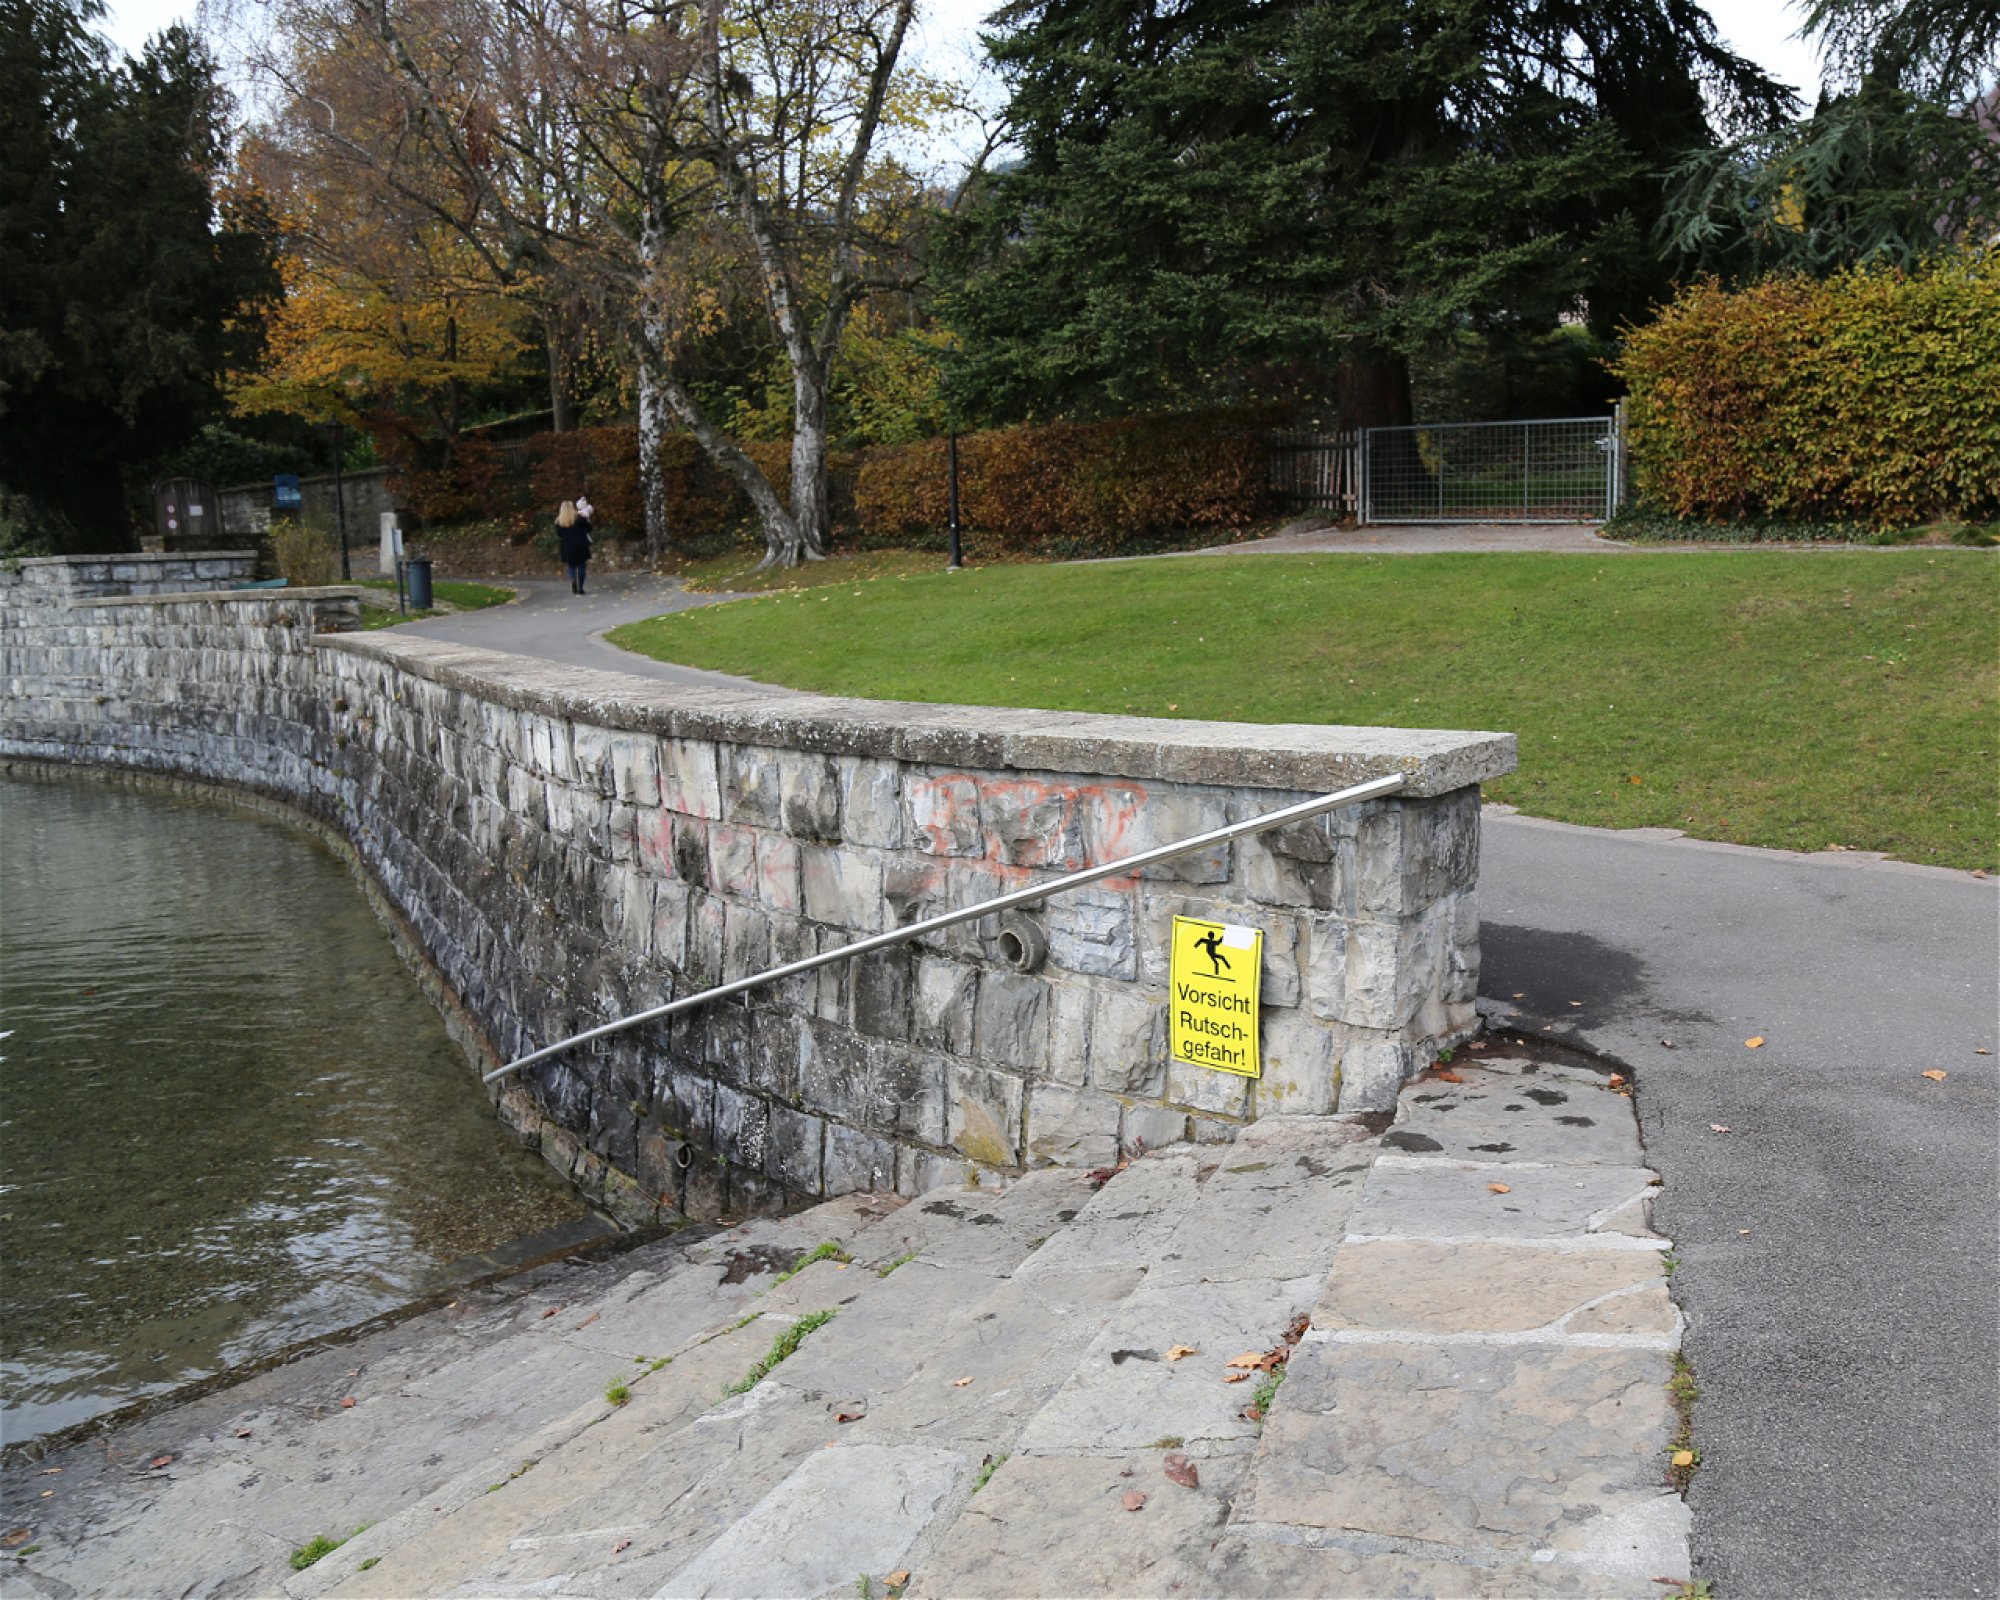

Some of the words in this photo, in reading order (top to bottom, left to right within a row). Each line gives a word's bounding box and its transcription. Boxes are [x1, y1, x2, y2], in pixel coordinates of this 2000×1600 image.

[1177, 982, 1251, 1015] Vorsicht
[1180, 1010, 1249, 1041] Rutsch-
[1183, 1040, 1246, 1067] gefahr!
